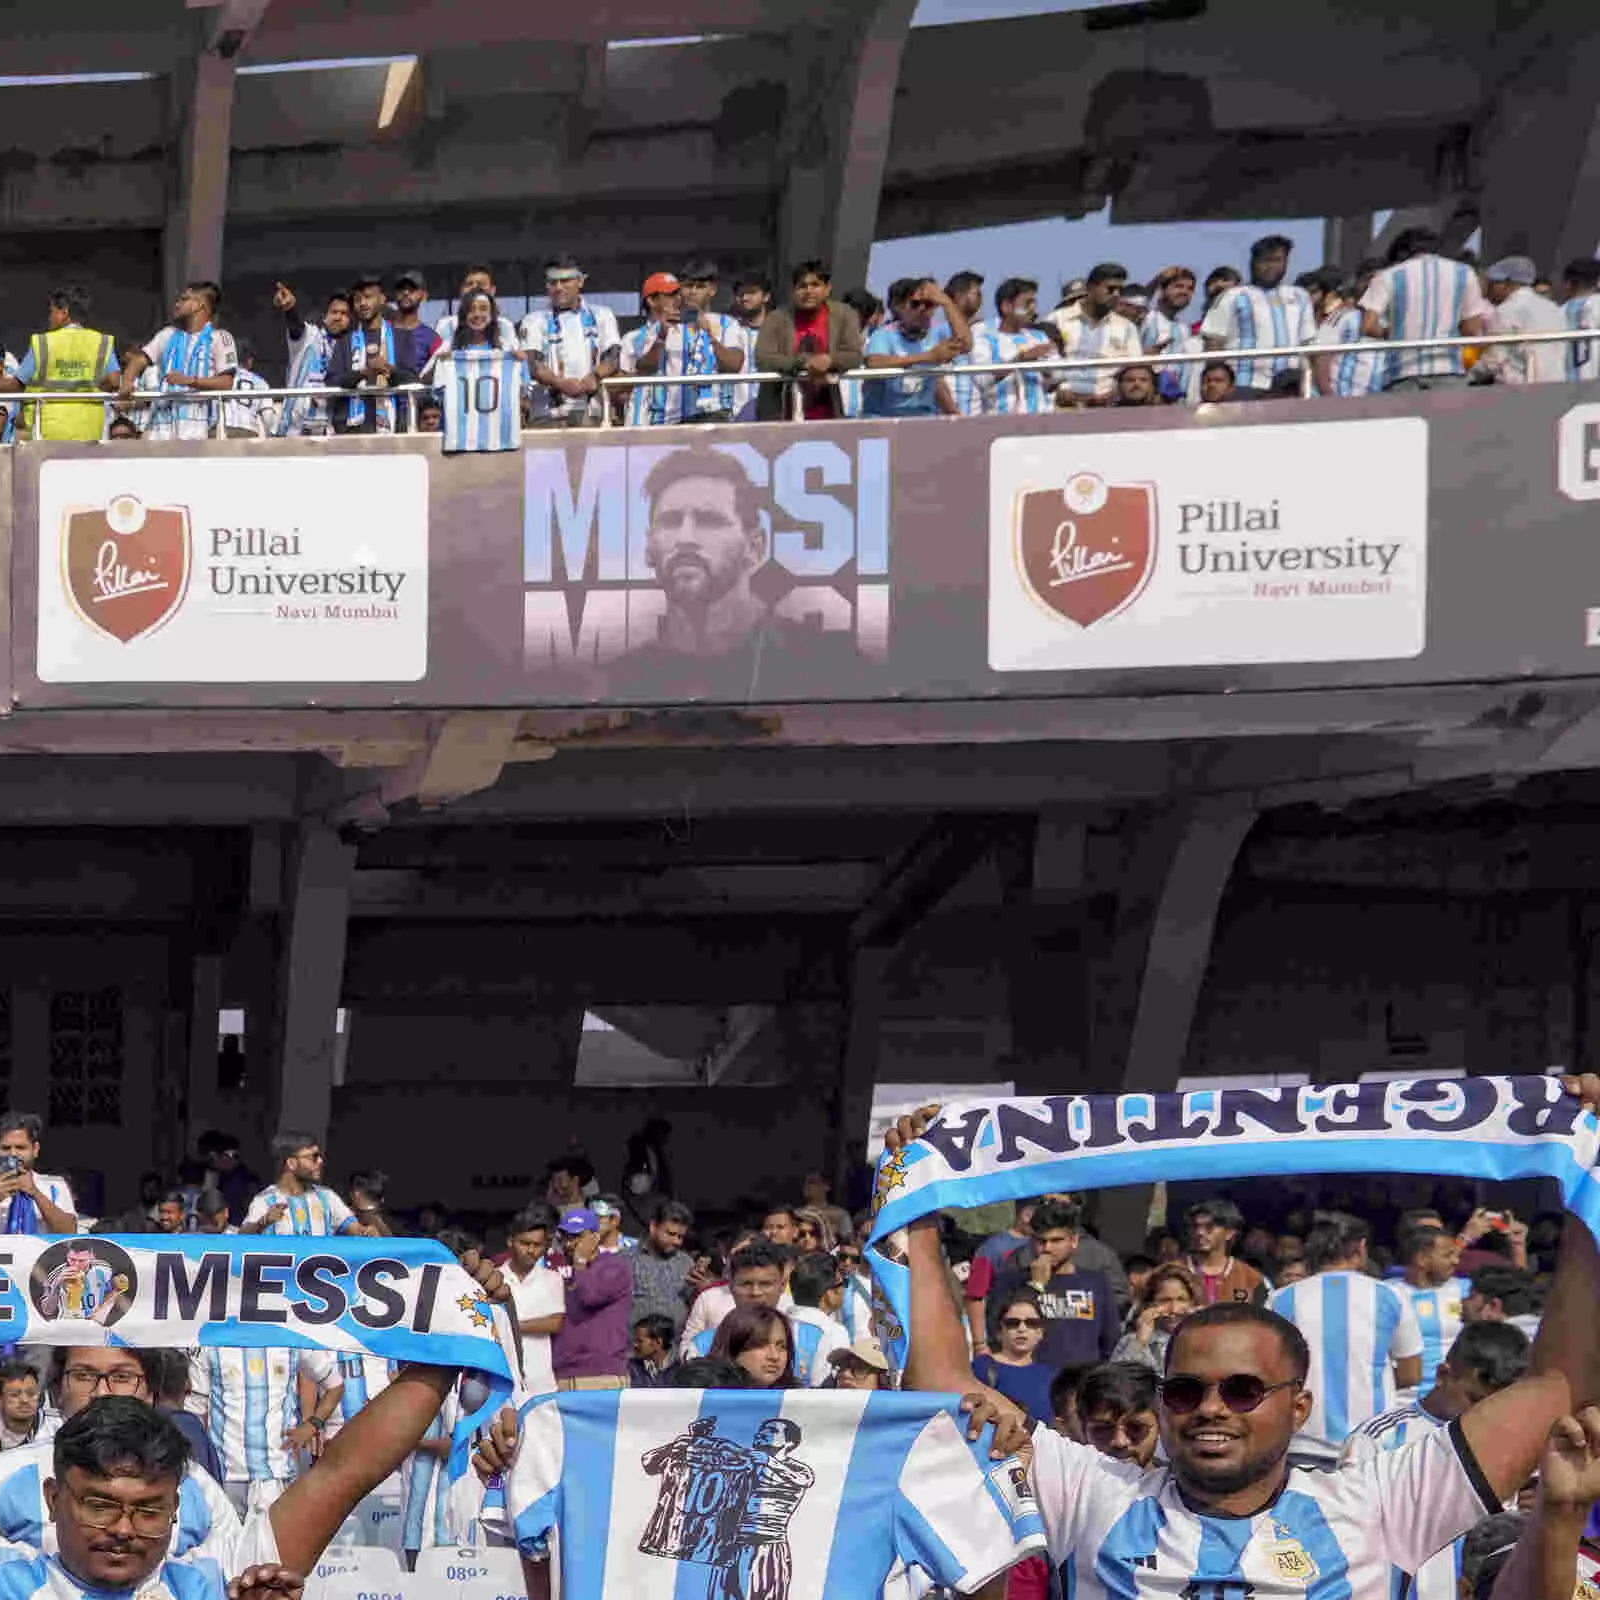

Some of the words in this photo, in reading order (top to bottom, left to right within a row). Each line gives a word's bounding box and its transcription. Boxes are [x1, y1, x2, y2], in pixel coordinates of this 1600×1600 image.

[458, 374, 499, 414] 10
[1177, 500, 1280, 535] Pillai
[209, 528, 301, 557] Pillai
[1178, 537, 1401, 575] University
[209, 565, 406, 602] University
[1253, 580, 1301, 598] Navi
[276, 604, 318, 619] Navi
[325, 603, 400, 620] Mumbai
[925, 1076, 1582, 1172] RGENTINA
[153, 1248, 445, 1335] MESSI
